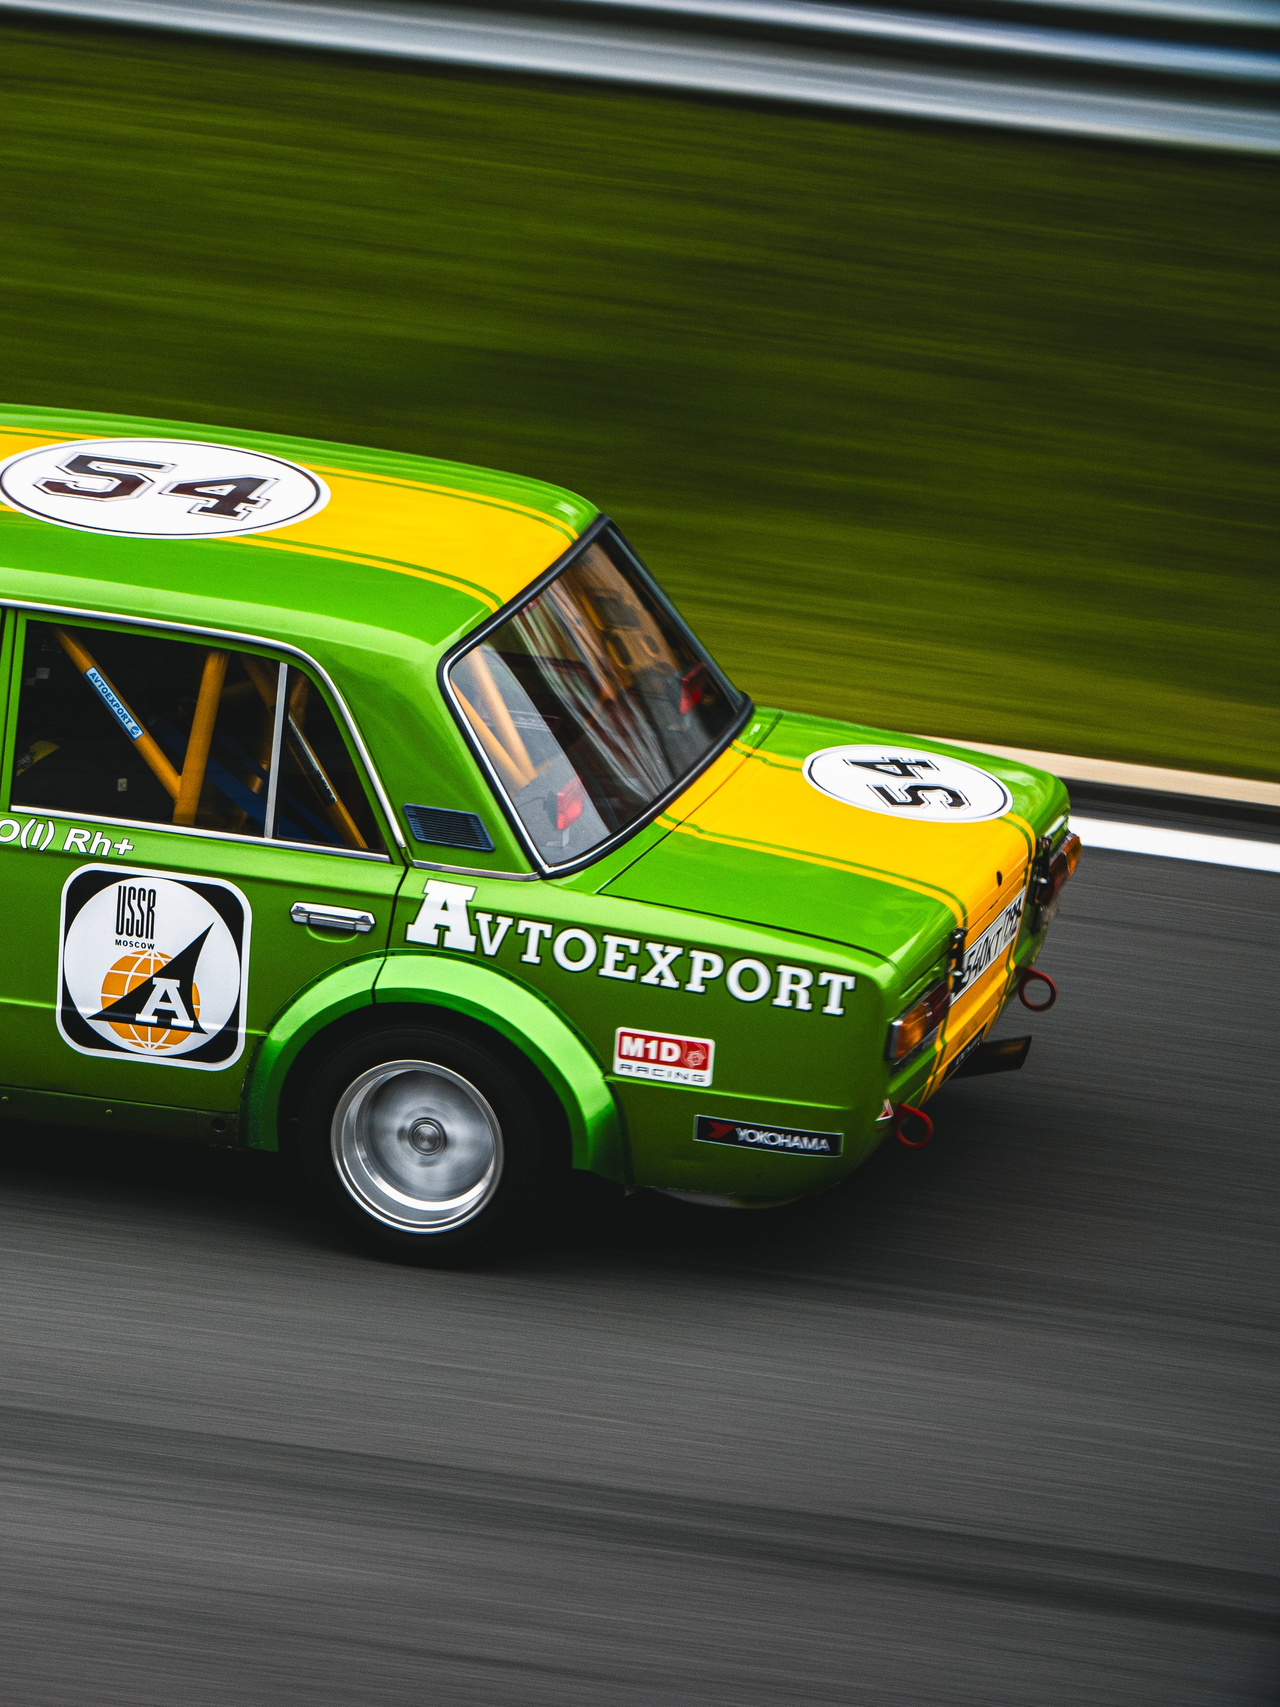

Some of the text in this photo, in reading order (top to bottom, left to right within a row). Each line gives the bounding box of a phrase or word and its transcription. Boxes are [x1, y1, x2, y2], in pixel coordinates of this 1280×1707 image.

[32, 451, 281, 521] 54
[89, 672, 132, 725] AVTOEXPORT
[842, 756, 972, 810] 54
[62, 827, 135, 857] Rh+
[115, 885, 157, 940] USSR
[114, 938, 156, 950] MOSCOW
[405, 877, 856, 1016] AVTOEXPORT
[135, 977, 195, 1029] A
[620, 1035, 682, 1064] M1D
[620, 1062, 706, 1084] RACING
[735, 1127, 831, 1152] YOKOHAMA
